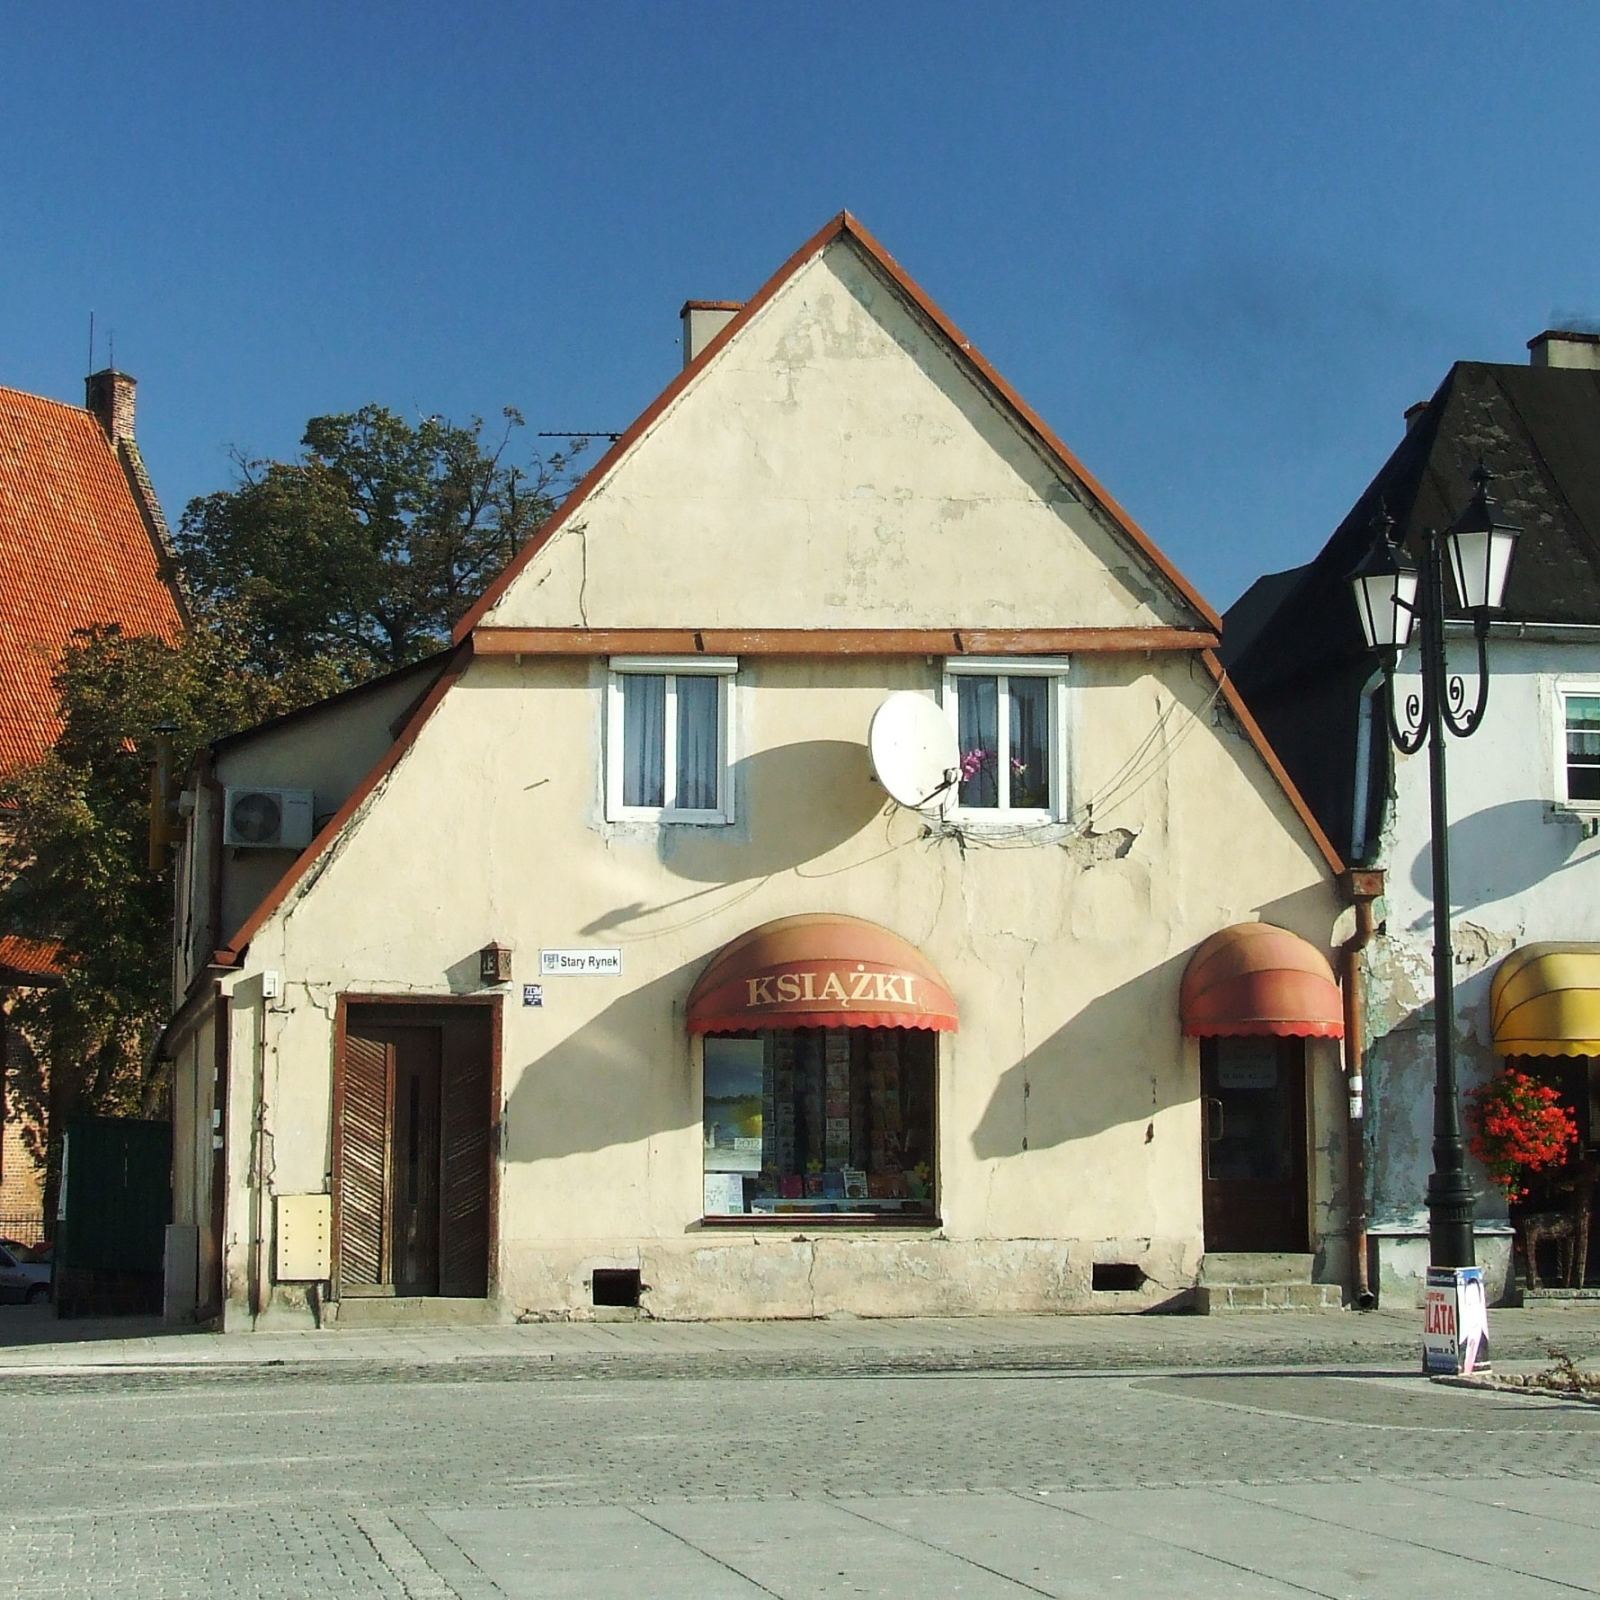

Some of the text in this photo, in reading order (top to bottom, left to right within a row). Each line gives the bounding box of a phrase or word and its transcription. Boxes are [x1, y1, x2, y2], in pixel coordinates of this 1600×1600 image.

[560, 955, 618, 969] Stary Rynek
[746, 964, 917, 1007] KSIĄŻKI
